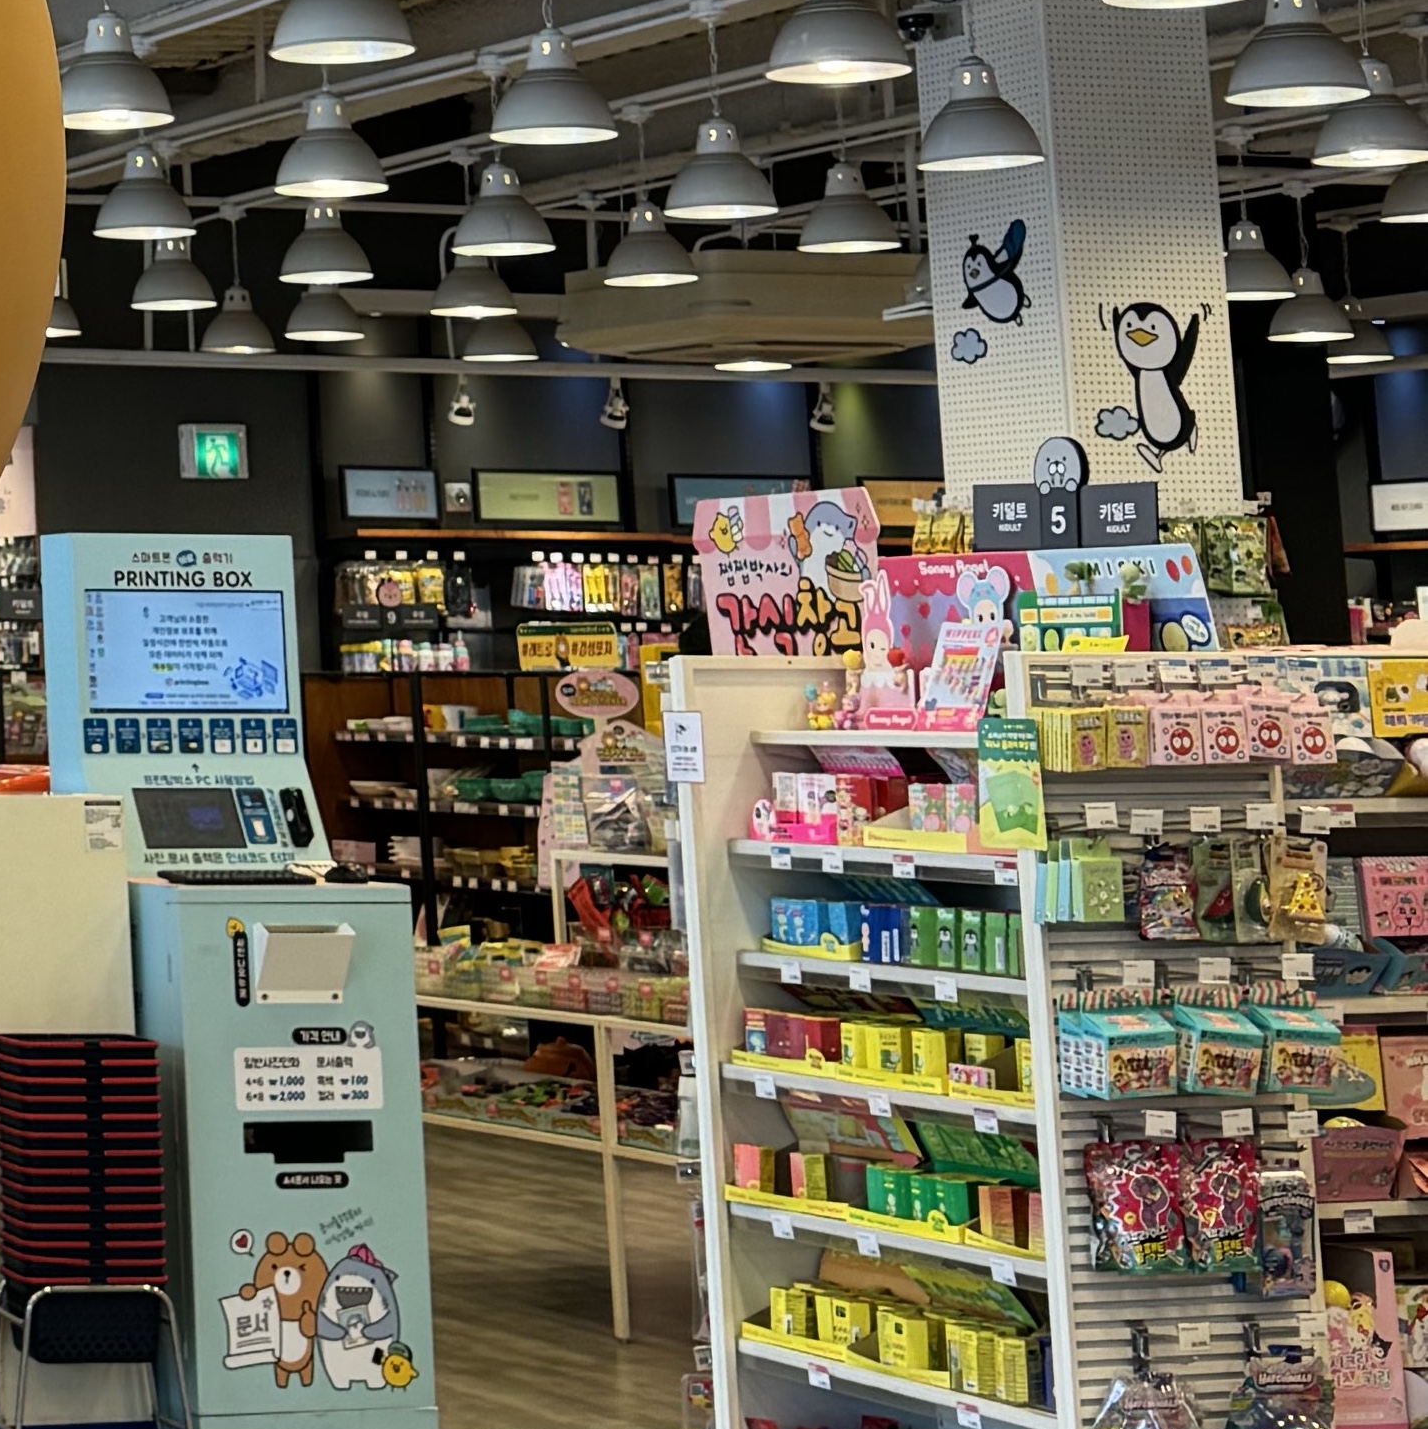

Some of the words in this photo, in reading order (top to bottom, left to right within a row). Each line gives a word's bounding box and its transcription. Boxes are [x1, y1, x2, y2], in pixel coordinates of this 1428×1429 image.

[992, 502, 1028, 520] 키덜트
[1050, 506, 1066, 534] 5
[1099, 502, 1137, 521] 키덜트
[132, 552, 171, 564] 스마트폰
[918, 560, 955, 578] Sonny
[956, 558, 989, 575] Angel
[1082, 559, 1155, 576] MIKI
[114, 570, 205, 587] PRINTING
[213, 571, 253, 587] BOX
[387, 611, 397, 625] 9
[195, 775, 211, 785] PC
[300, 1031, 319, 1042] 가격
[321, 1030, 341, 1041] 안내
[316, 1056, 353, 1068] 문서출력
[236, 1312, 270, 1338] 문서
